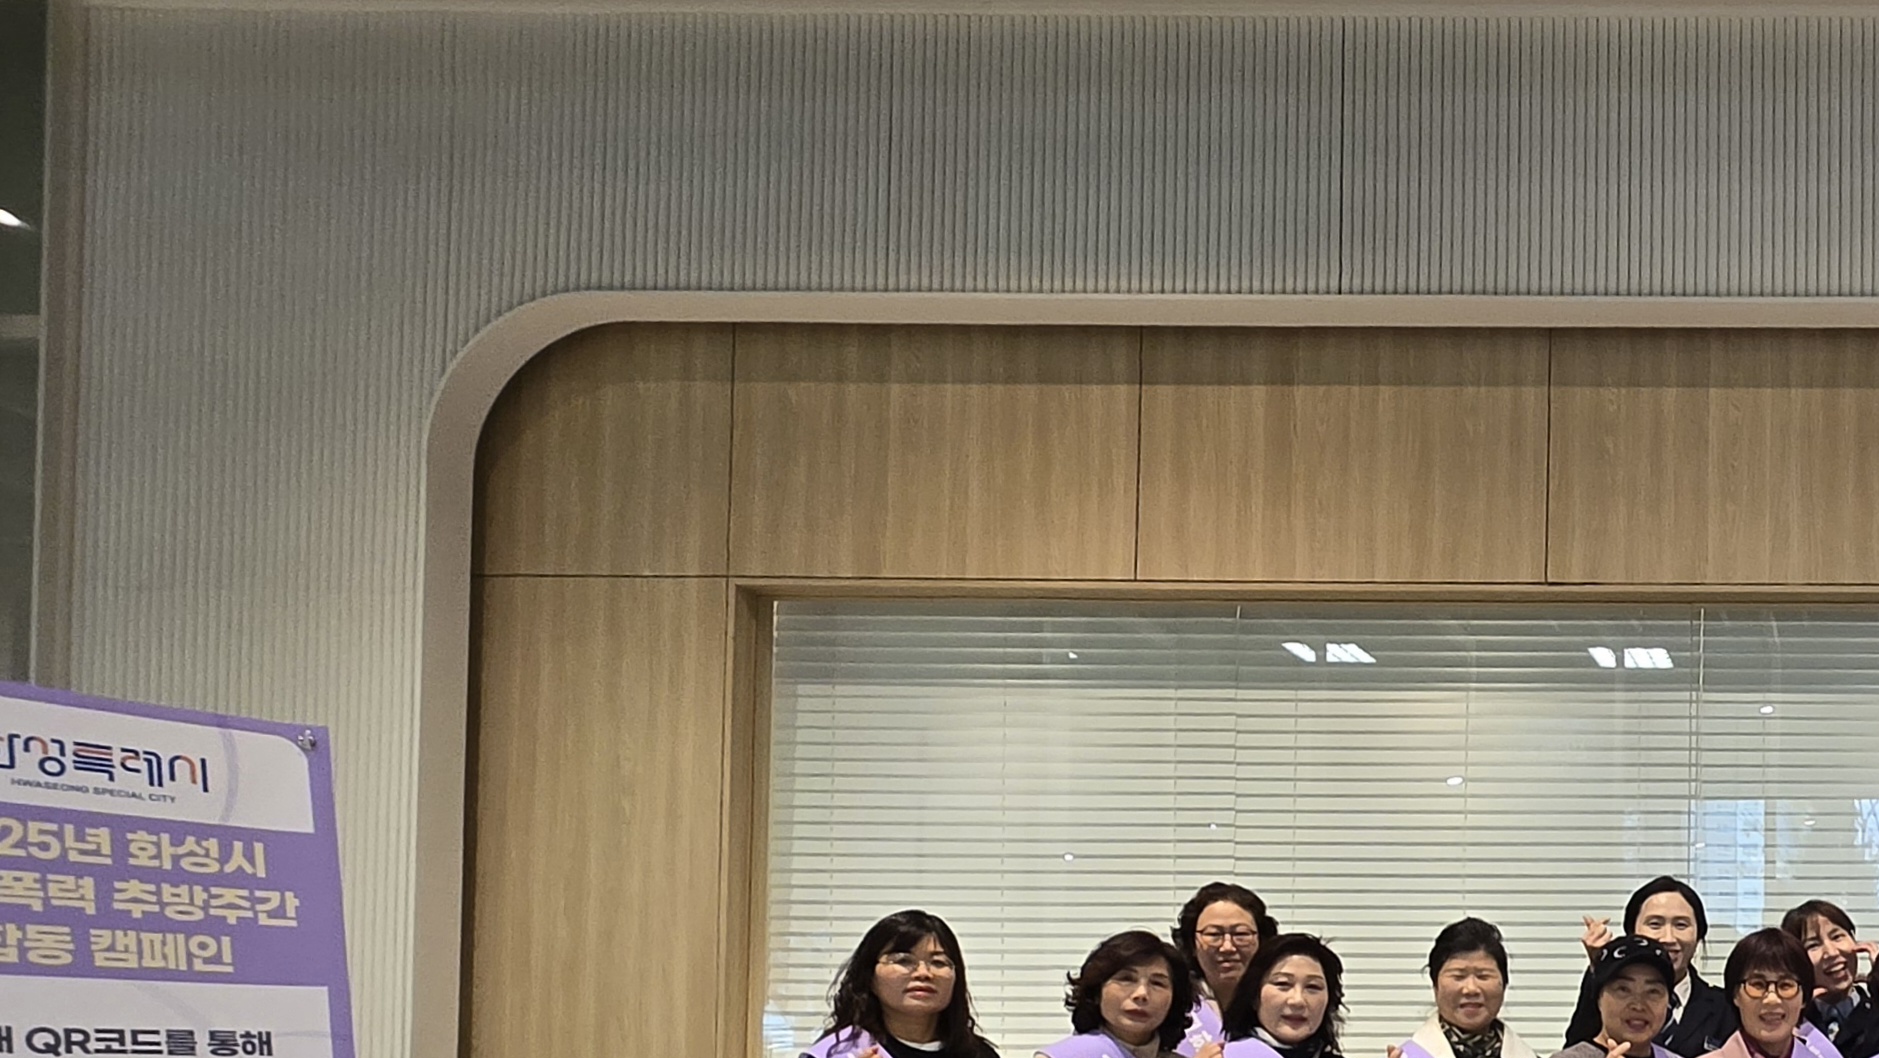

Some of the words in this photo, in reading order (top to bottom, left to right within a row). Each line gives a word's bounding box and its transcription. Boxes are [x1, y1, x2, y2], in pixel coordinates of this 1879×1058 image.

[11, 777, 90, 795] HWASEONG
[93, 786, 146, 801] SPECIAL
[149, 793, 176, 804] CITY
[125, 830, 266, 878] 화성시
[112, 878, 300, 927] 추방주간
[89, 928, 235, 973] 캠페인
[25, 1026, 198, 1058] QR코드를
[207, 1029, 274, 1058] 통해
